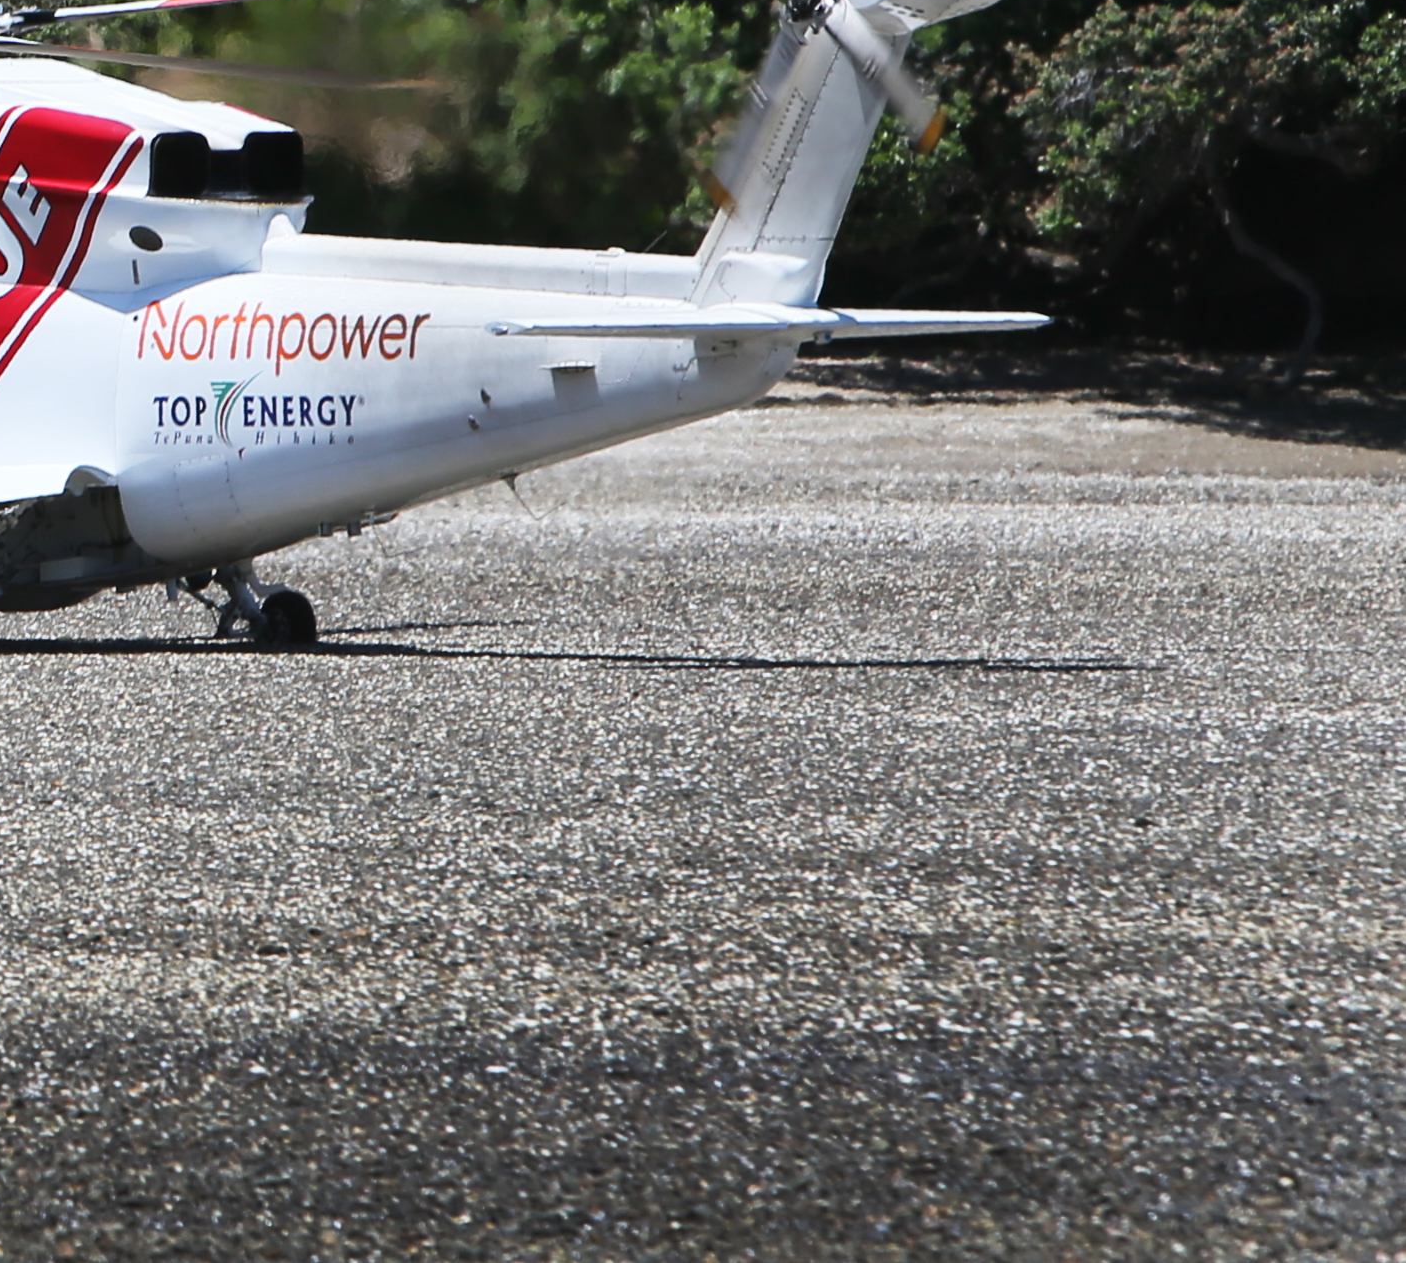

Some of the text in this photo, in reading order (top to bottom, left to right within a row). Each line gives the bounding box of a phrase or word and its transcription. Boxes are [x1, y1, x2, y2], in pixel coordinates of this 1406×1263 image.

[138, 300, 431, 377] Northpower
[153, 395, 356, 427] TOP ENERGY
[255, 430, 355, 445] Hihiko
